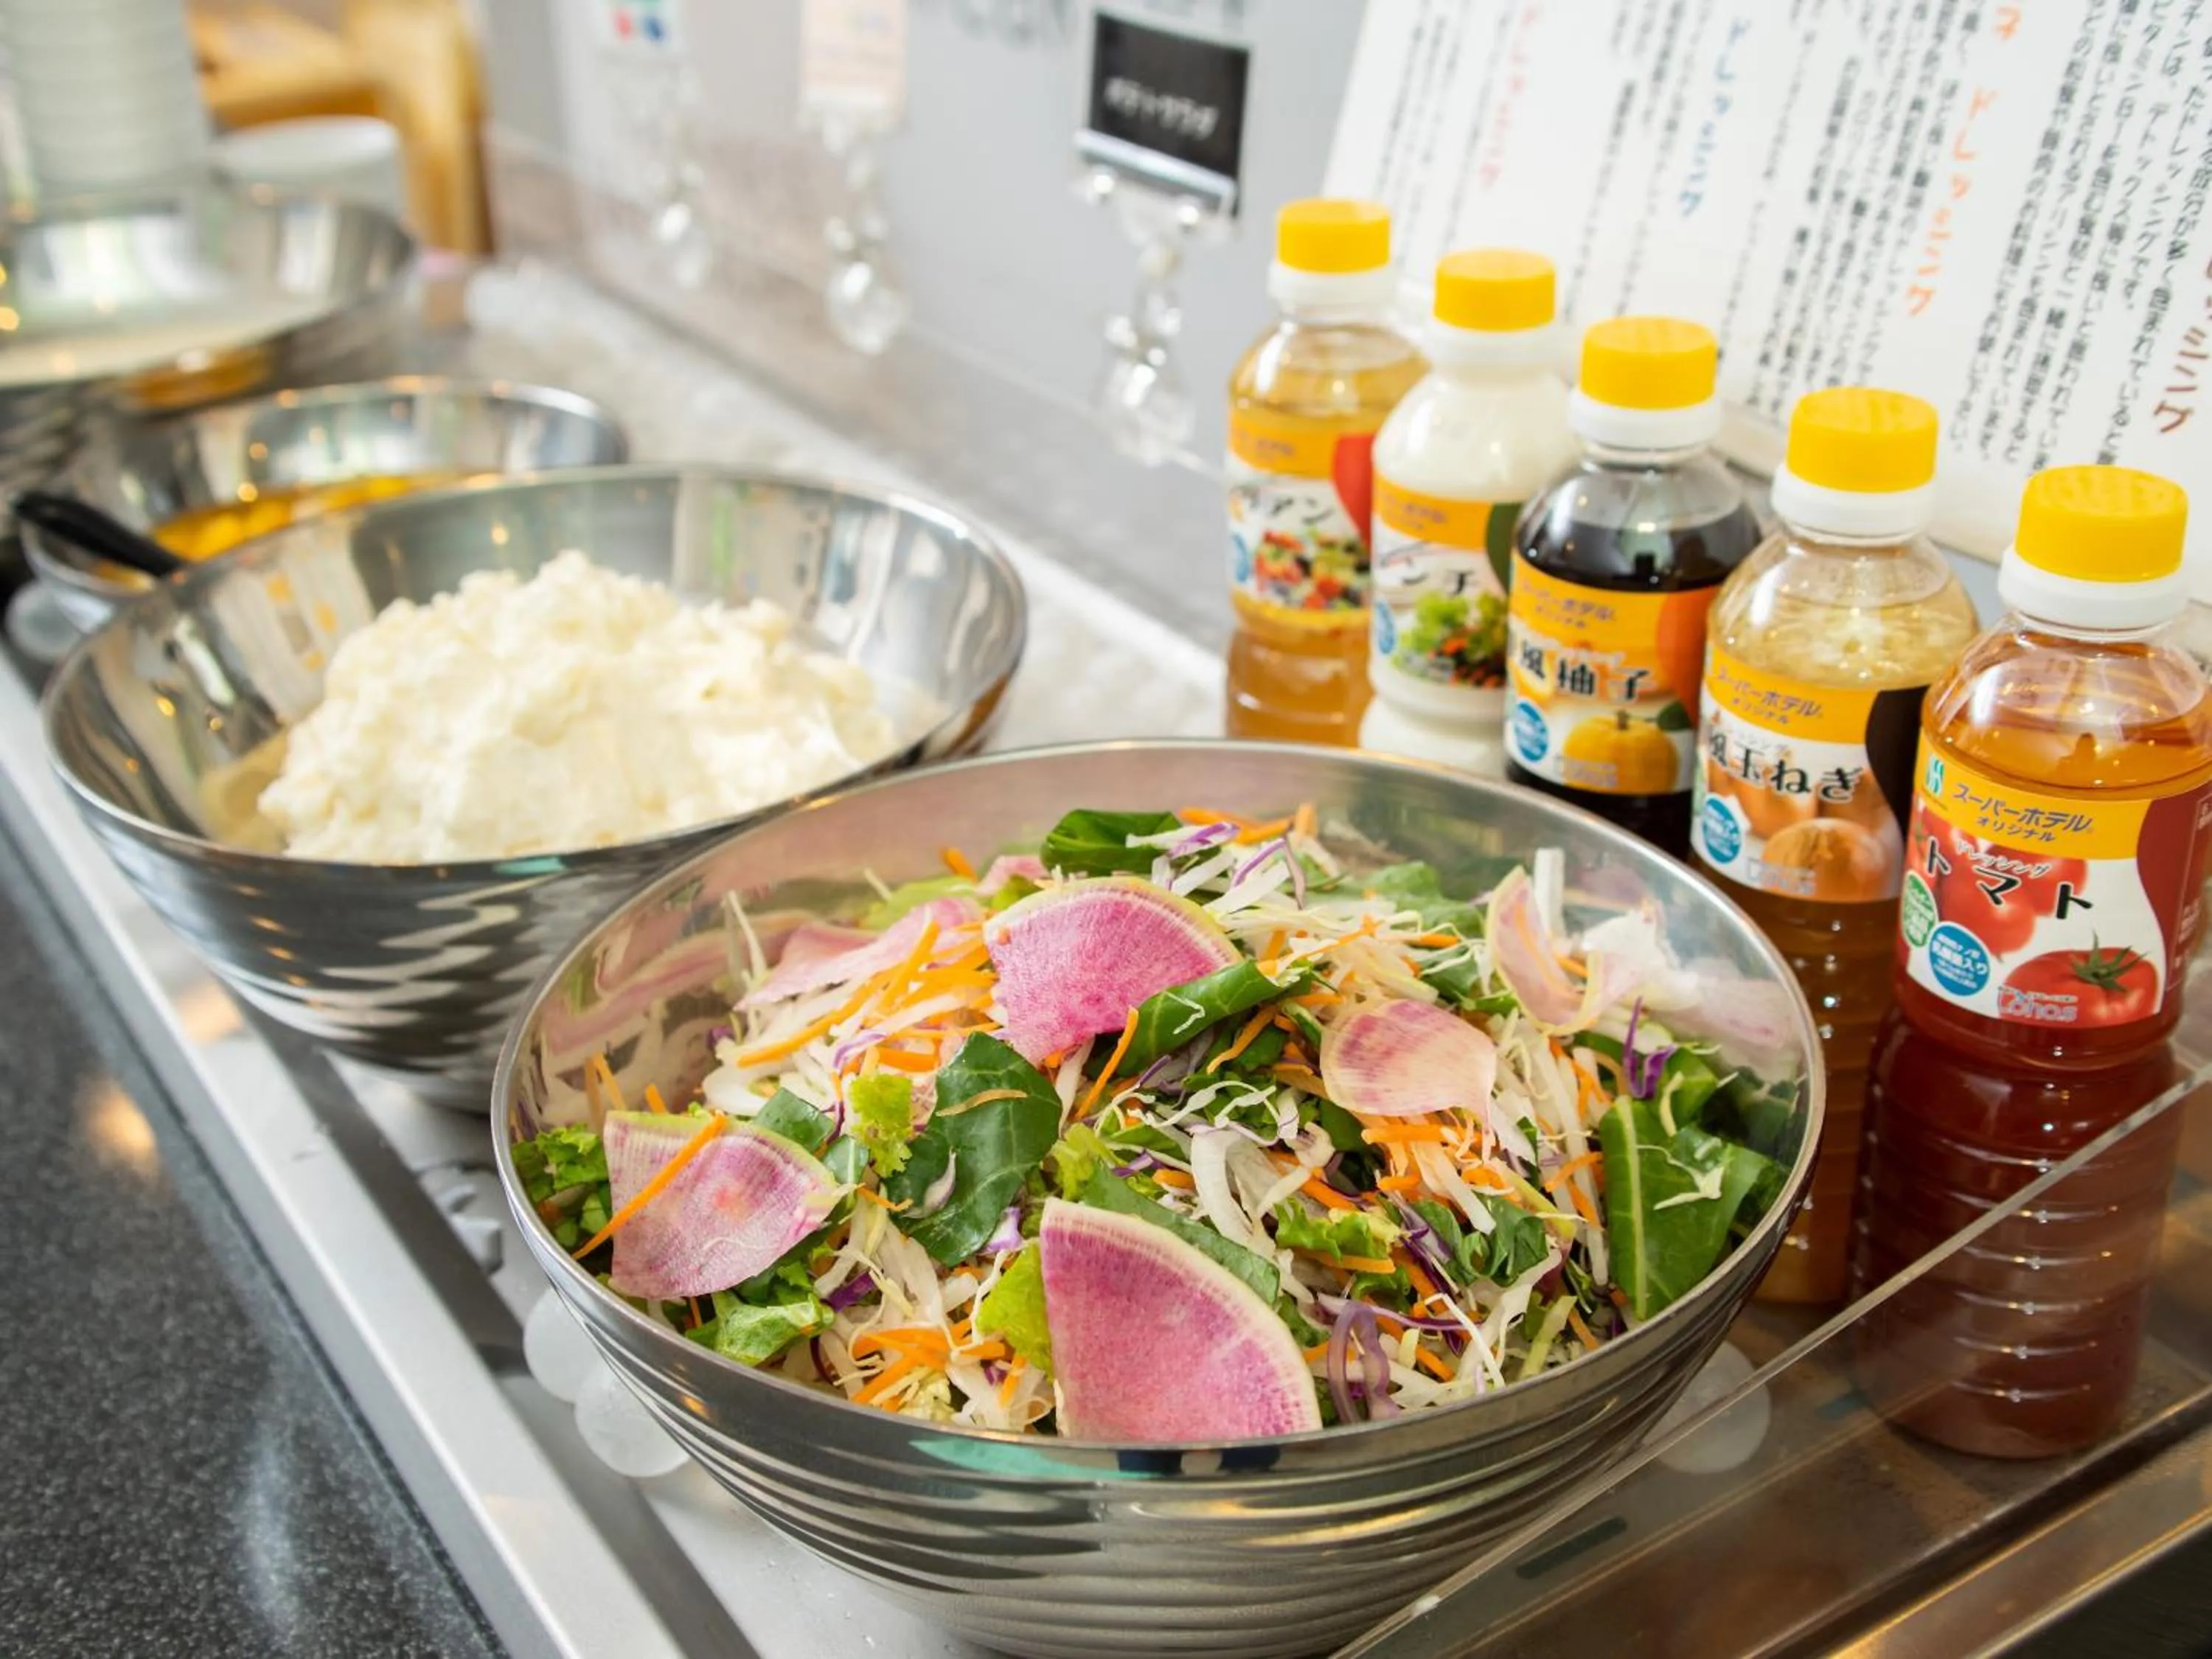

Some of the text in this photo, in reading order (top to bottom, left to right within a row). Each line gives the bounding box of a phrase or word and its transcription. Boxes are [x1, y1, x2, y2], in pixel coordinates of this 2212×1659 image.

[1952, 783, 2094, 832] スーパーホテル
[1976, 815, 2056, 843] オリジナル
[1927, 838, 2093, 920] トマト
